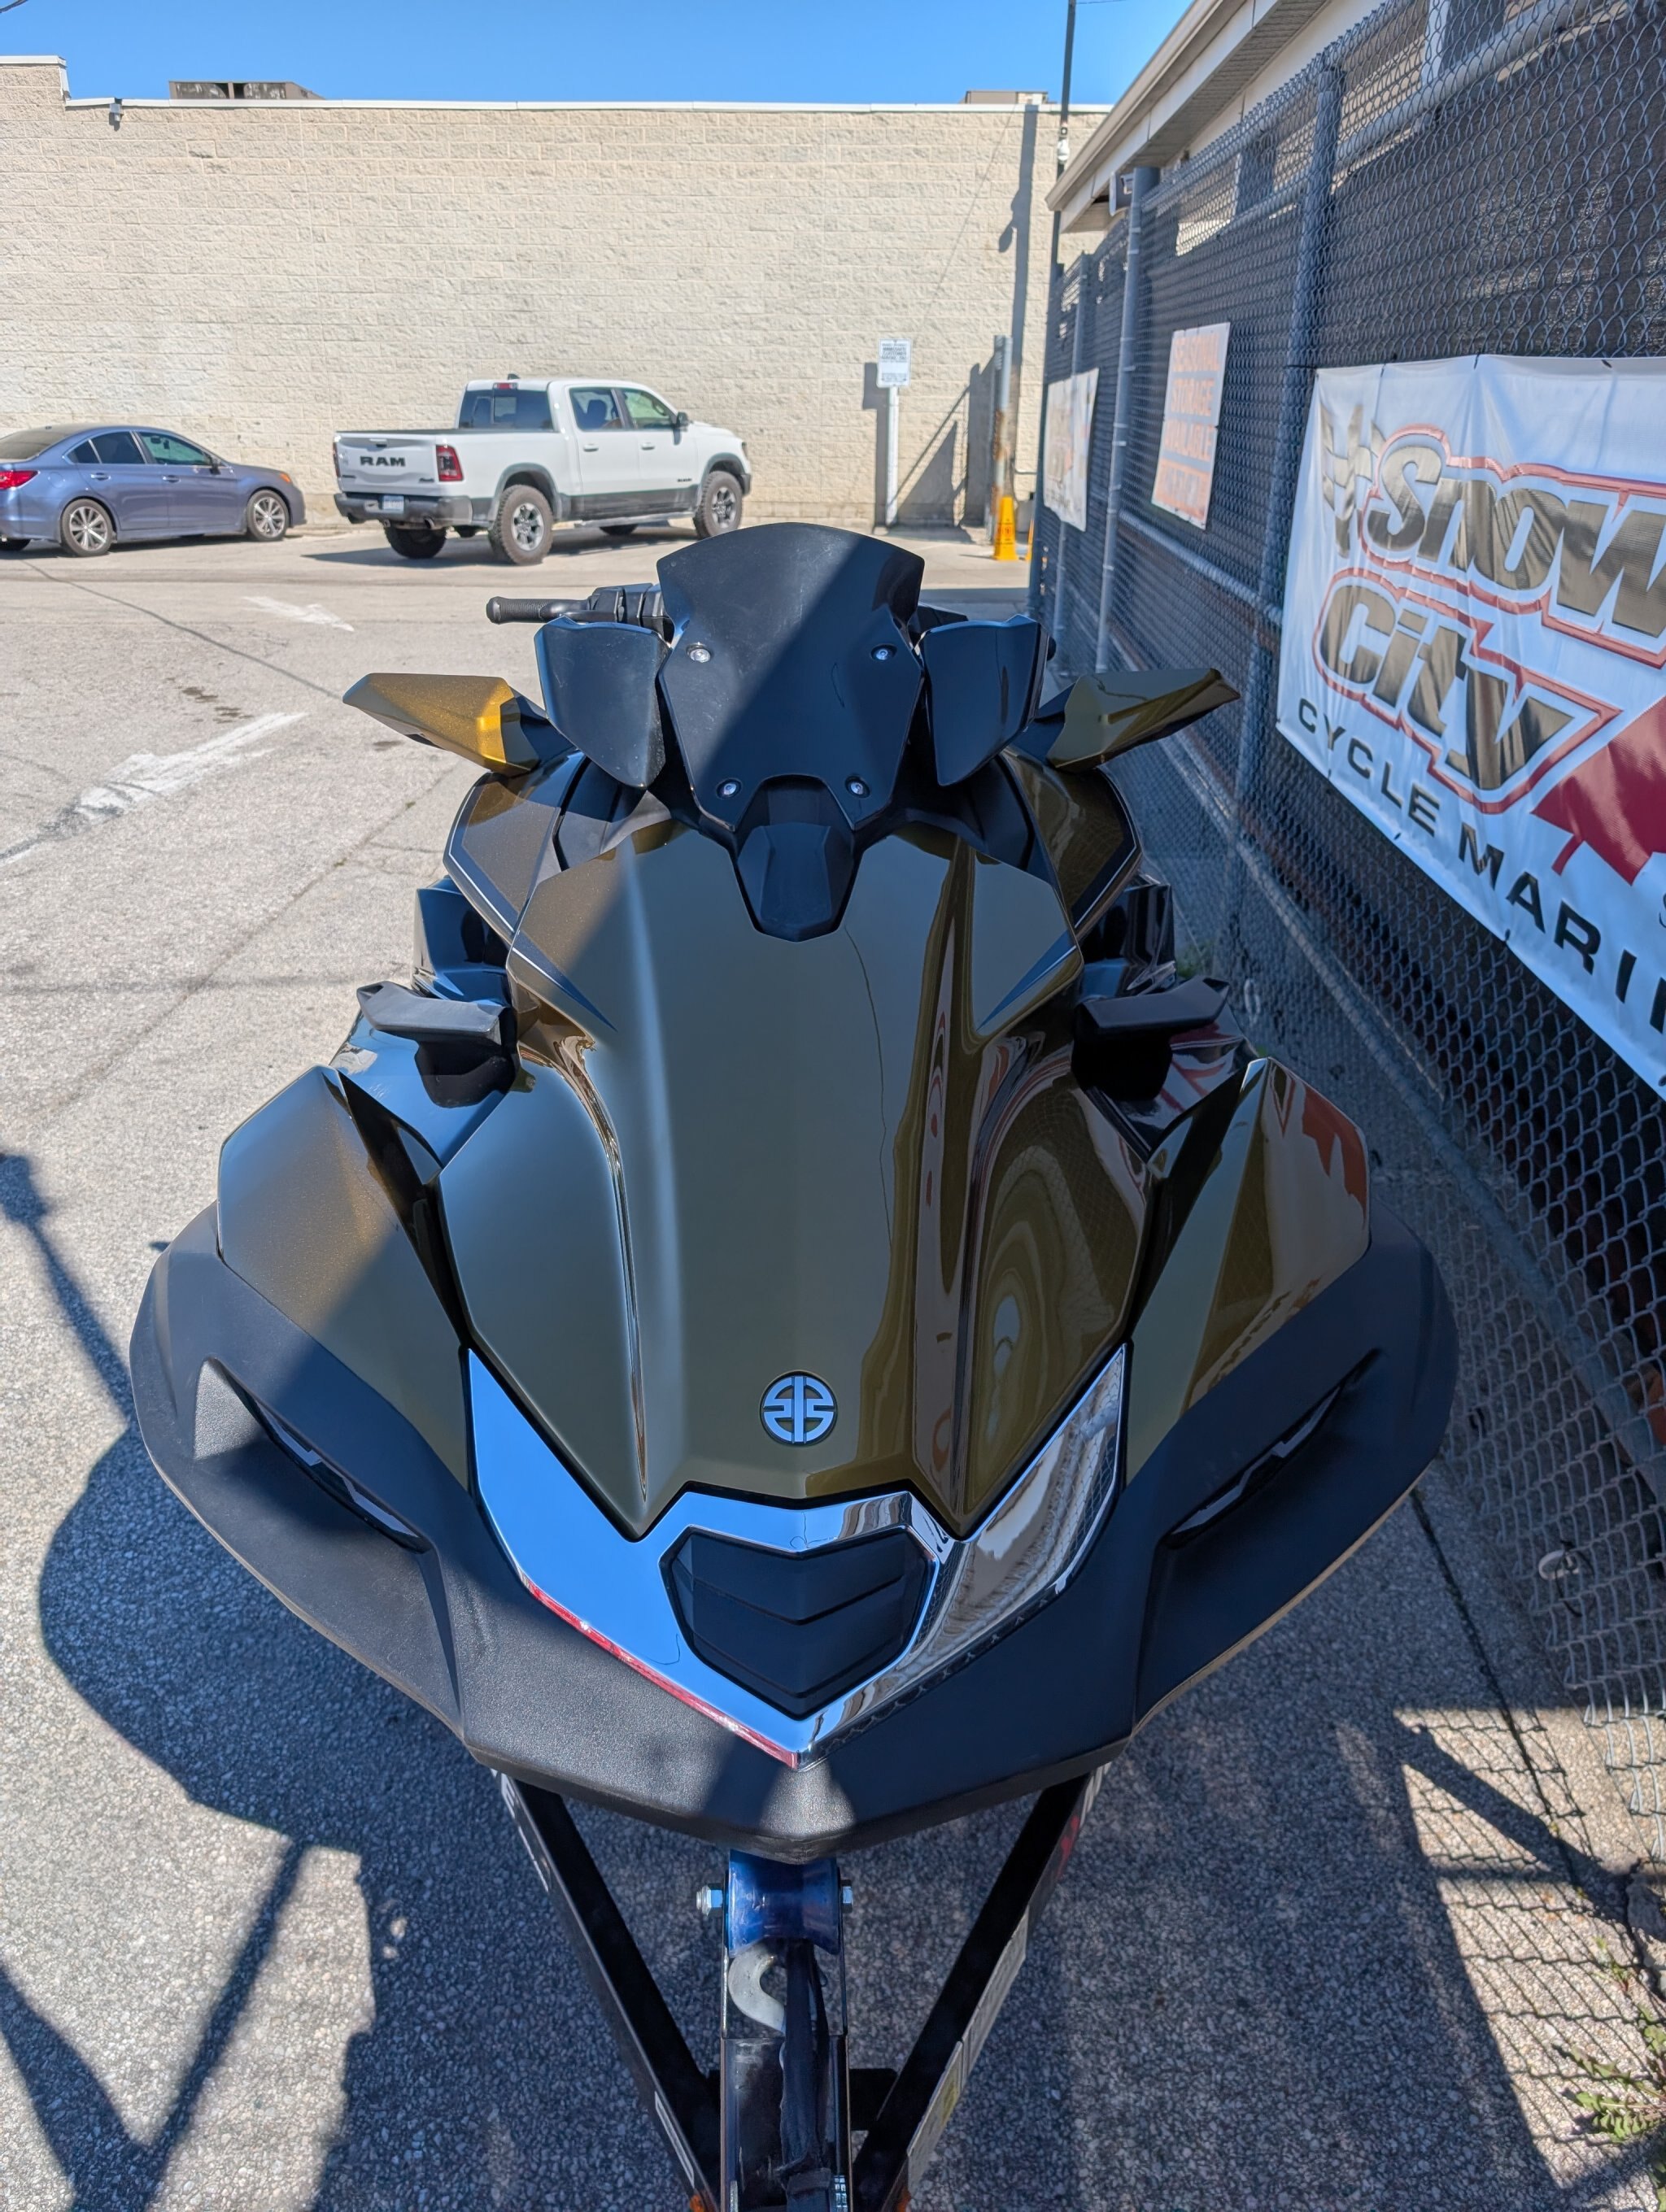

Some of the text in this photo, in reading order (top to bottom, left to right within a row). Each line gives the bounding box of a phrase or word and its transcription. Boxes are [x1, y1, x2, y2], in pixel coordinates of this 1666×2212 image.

[1171, 378, 1215, 417] STORAGE
[360, 455, 406, 467] RAM
[1163, 419, 1213, 462] AVAILABLE
[1299, 697, 1441, 838] CYCLE
